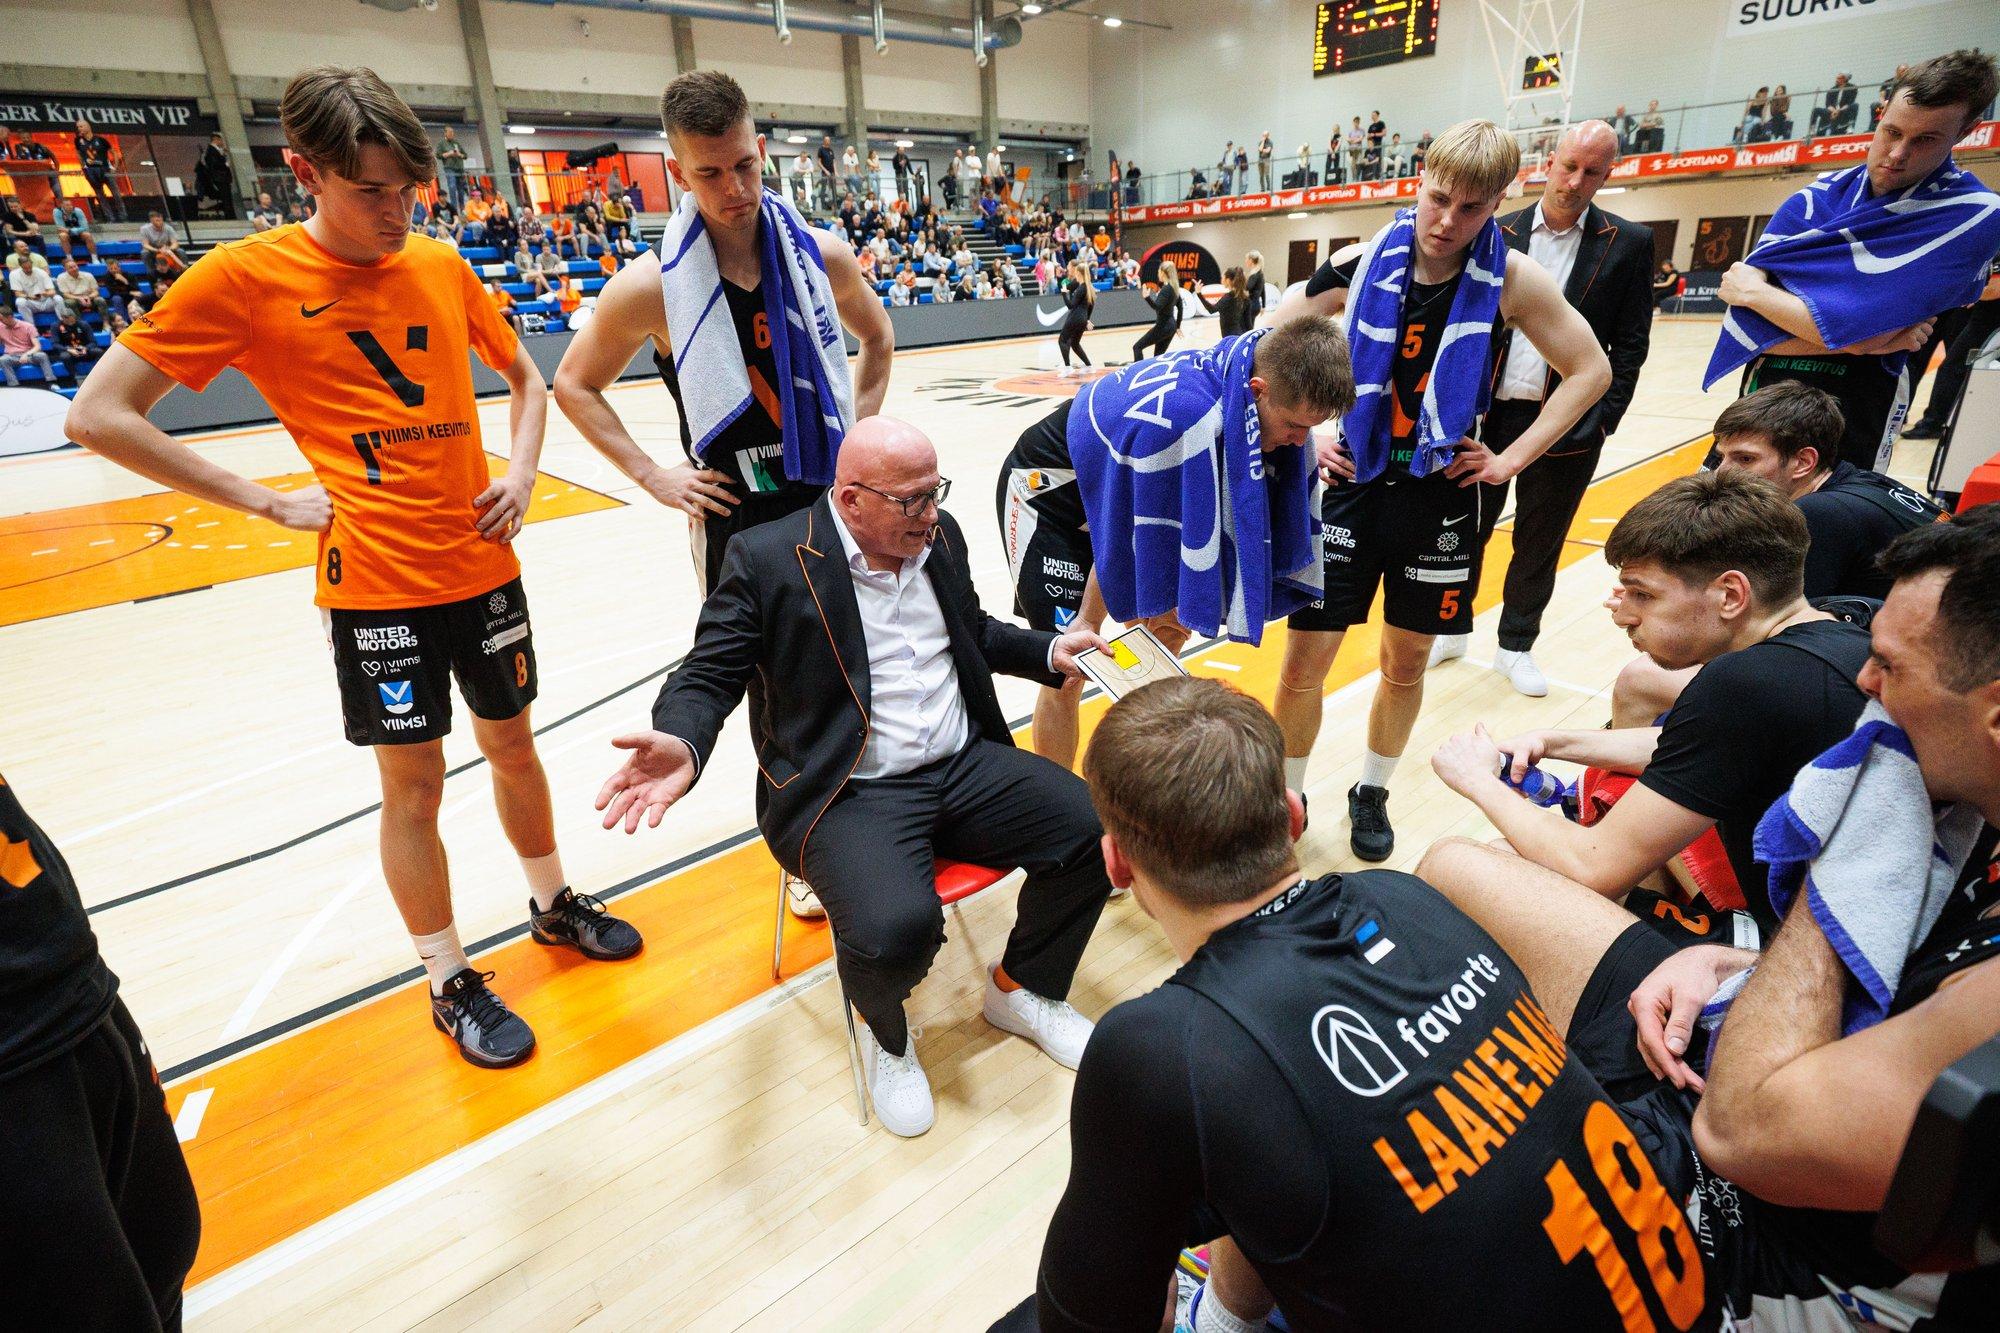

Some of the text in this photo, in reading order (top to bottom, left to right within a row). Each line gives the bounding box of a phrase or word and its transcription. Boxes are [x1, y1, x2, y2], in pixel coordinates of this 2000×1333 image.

[43, 102, 147, 125] KITCHEN
[148, 105, 191, 126] VIP
[1666, 153, 1729, 169] SPORTLAND
[1756, 144, 1797, 164] VIIMSI
[753, 312, 771, 350] 6
[1402, 324, 1426, 359] 5
[1790, 357, 1848, 376] KEEVITUS
[381, 421, 471, 446] VIIMSI KEEVITUS
[327, 546, 342, 586] 8
[1042, 565, 1085, 582] MOTORS
[1439, 589, 1462, 620] 5
[356, 634, 419, 651] MOTORS
[514, 651, 528, 688] 8
[382, 715, 428, 731] VIIMSI
[1396, 952, 1501, 1059] favorte
[1541, 1100, 1706, 1333] 18
